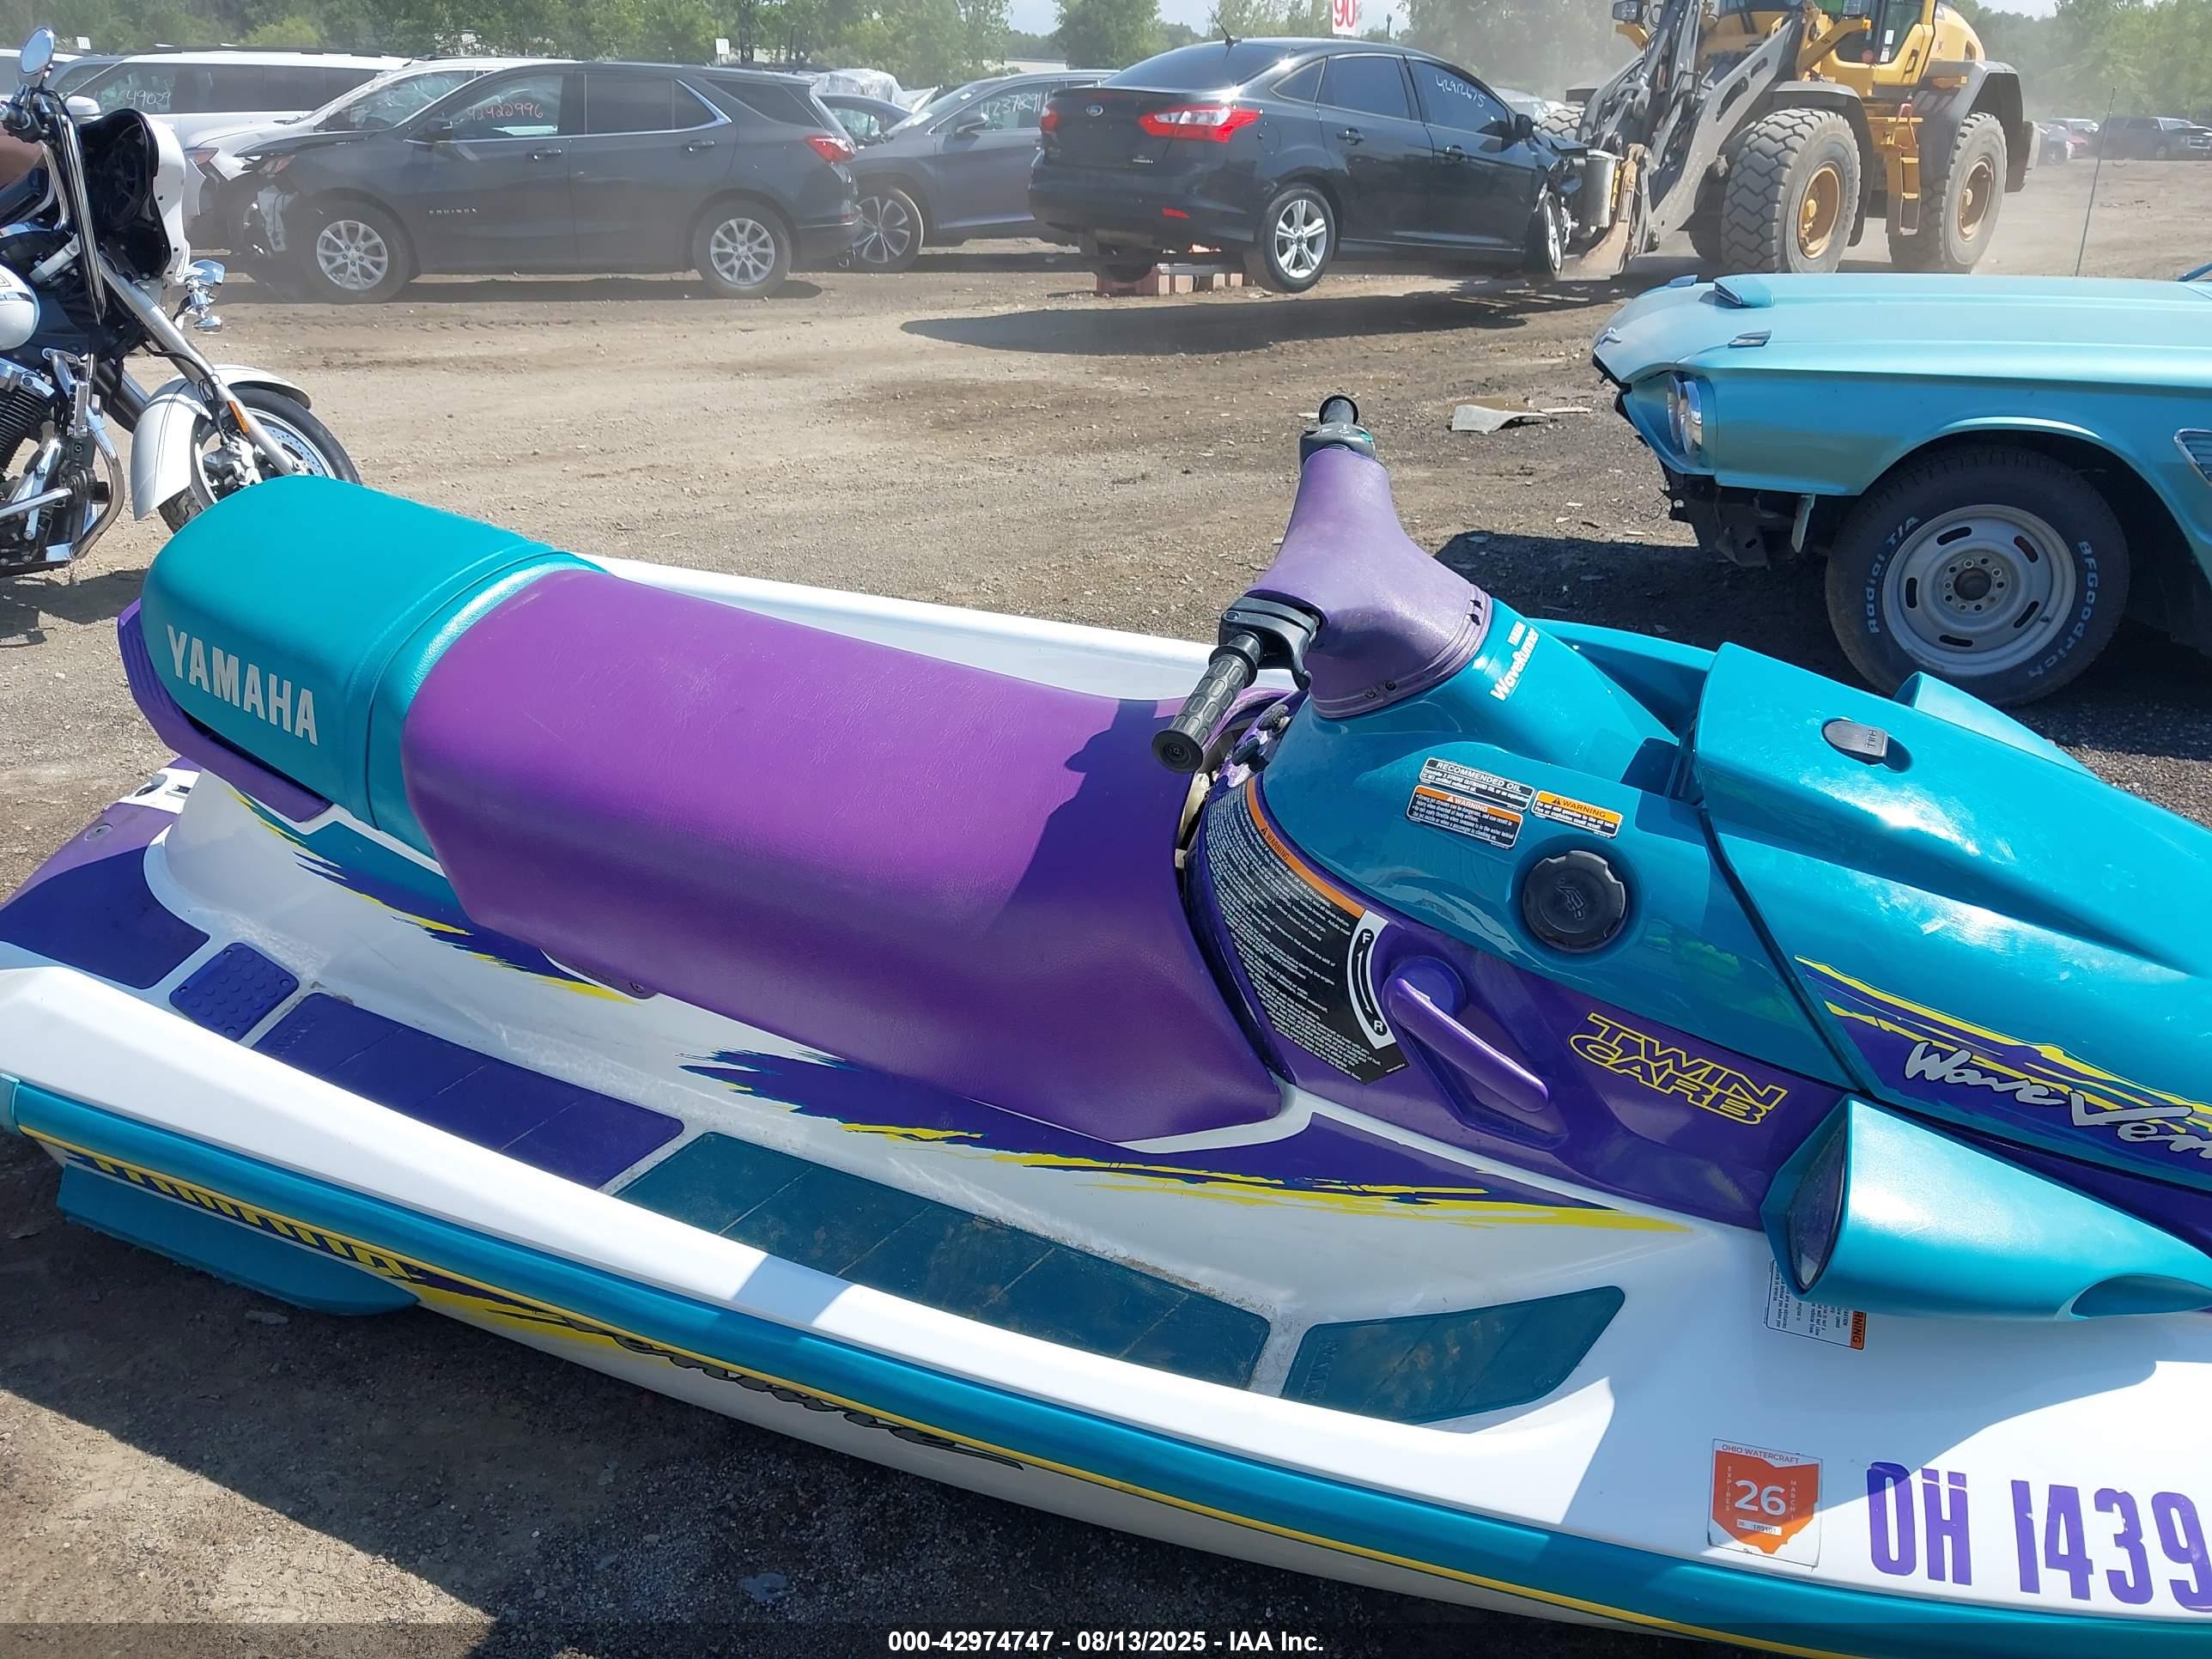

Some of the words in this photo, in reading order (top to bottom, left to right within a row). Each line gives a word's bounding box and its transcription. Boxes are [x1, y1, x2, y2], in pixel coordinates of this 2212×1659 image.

[1334, 0, 1356, 27] 90
[1865, 553, 1885, 634] Radial
[1885, 516, 1920, 546] T/A
[167, 624, 319, 747] YAMAHA
[1436, 762, 1505, 787] RECOMMENDED
[1506, 782, 1522, 793] OIL
[1454, 797, 1488, 811] WARNING
[1563, 799, 1606, 818] WARNING
[1266, 832, 1290, 860] WARNING
[1362, 933, 1371, 945] F
[1374, 1020, 1384, 1032] R
[1587, 1012, 1789, 1110] TWIN
[1905, 1040, 2069, 1106] Wave
[1569, 1034, 1767, 1125] CARB
[1722, 1443, 1743, 1454] OHIO
[1744, 1448, 1801, 1464] WATERCRAFT
[1735, 1480, 1786, 1516] 26
[1866, 1462, 1972, 1586] OH
[2010, 1480, 2212, 1613] 1439
